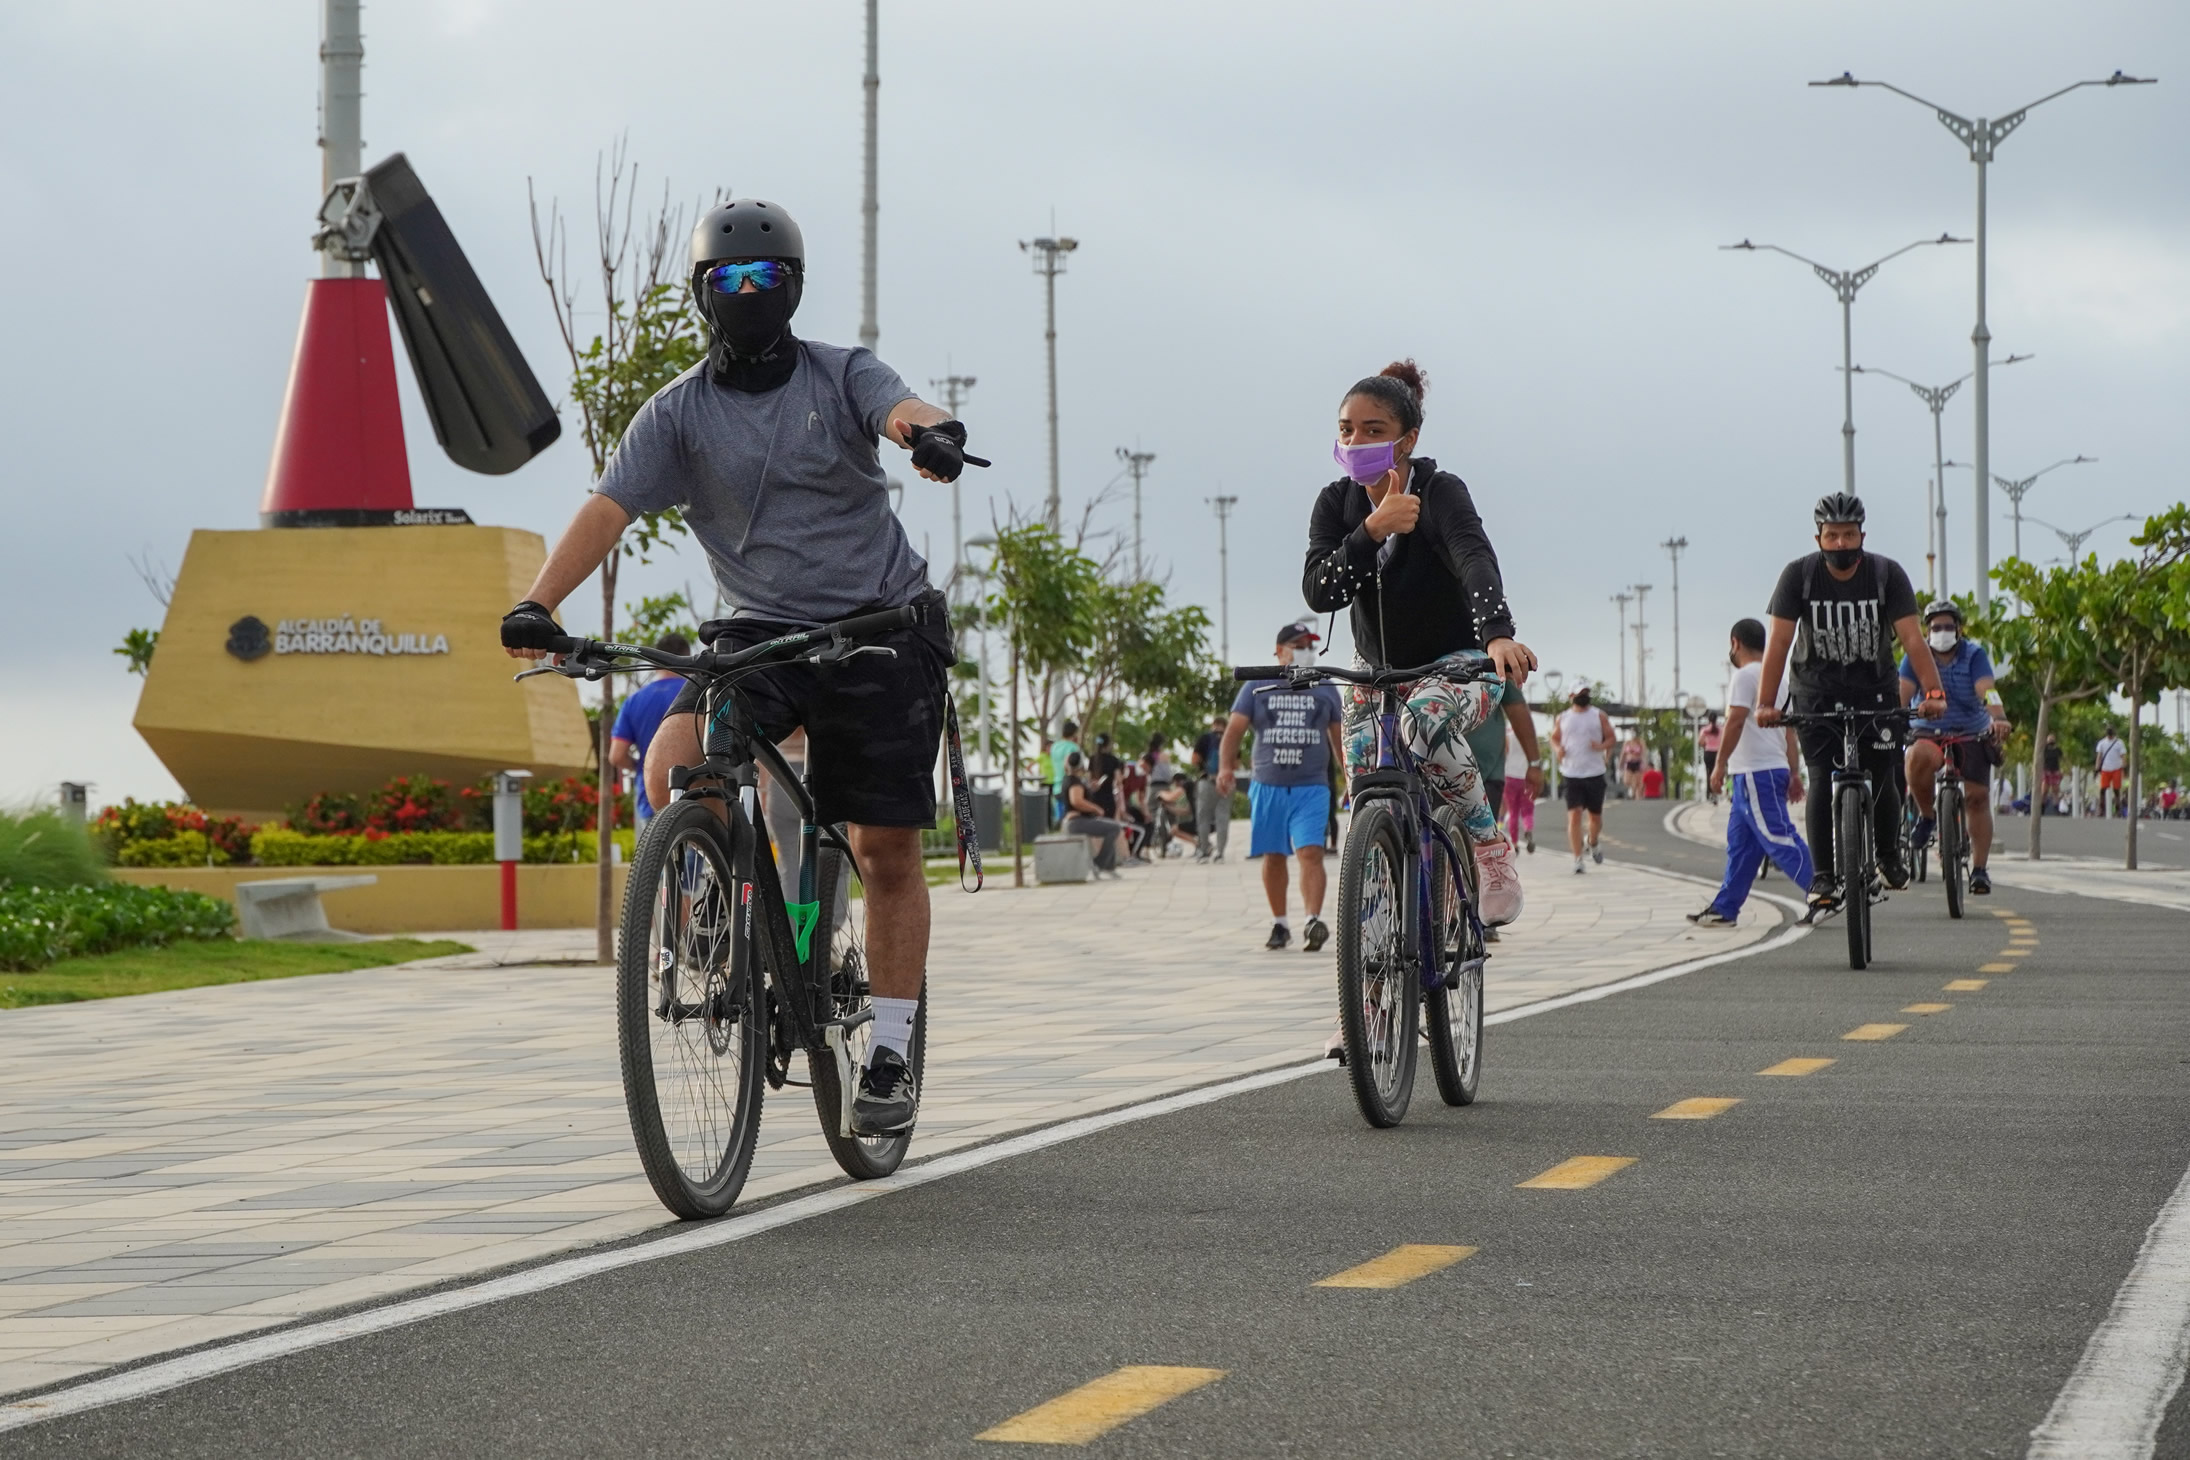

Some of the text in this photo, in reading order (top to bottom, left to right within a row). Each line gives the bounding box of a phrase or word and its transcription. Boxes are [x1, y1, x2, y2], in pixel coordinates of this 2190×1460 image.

[277, 613, 381, 634] ALCALDÍA DE
[275, 634, 449, 656] BARRANQUILLA
[1268, 695, 1315, 710] DANGER
[1276, 710, 1306, 727] ZONE
[1272, 748, 1303, 765] ZONE
[960, 792, 971, 821] CADENAS
